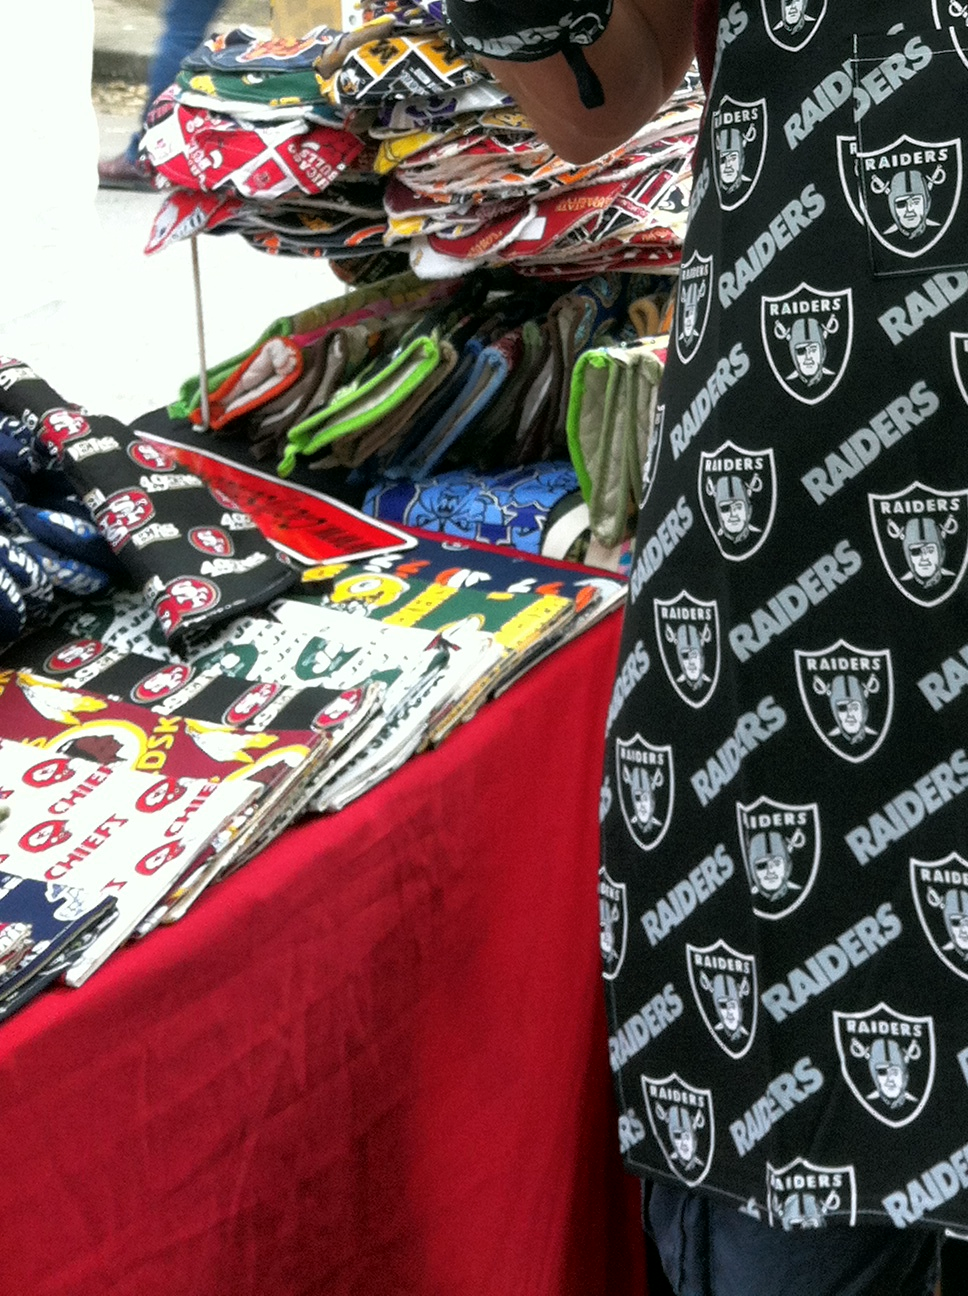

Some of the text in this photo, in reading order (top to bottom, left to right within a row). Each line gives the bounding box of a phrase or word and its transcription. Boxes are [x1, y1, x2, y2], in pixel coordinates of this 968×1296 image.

[865, 148, 949, 172] RAIDERS
[718, 183, 827, 309] RAIDERS
[769, 297, 842, 316] RAIDERS
[669, 342, 751, 461] RAIDERS
[800, 380, 940, 505] RAIDERS
[704, 456, 764, 473] RAIDERS
[879, 498, 961, 515] RAIDERS
[728, 538, 863, 663] RAIDERS
[660, 606, 713, 622] RAIDERS
[806, 656, 882, 672] RAIDERS
[45, 812, 130, 881] CHIEFS
[640, 843, 734, 947] RAIDERS
[694, 954, 751, 974] RAIDERS
[761, 903, 902, 1023] RAIDERS
[846, 1019, 923, 1037] RAIDERS
[649, 1085, 705, 1107] RAIDERS
